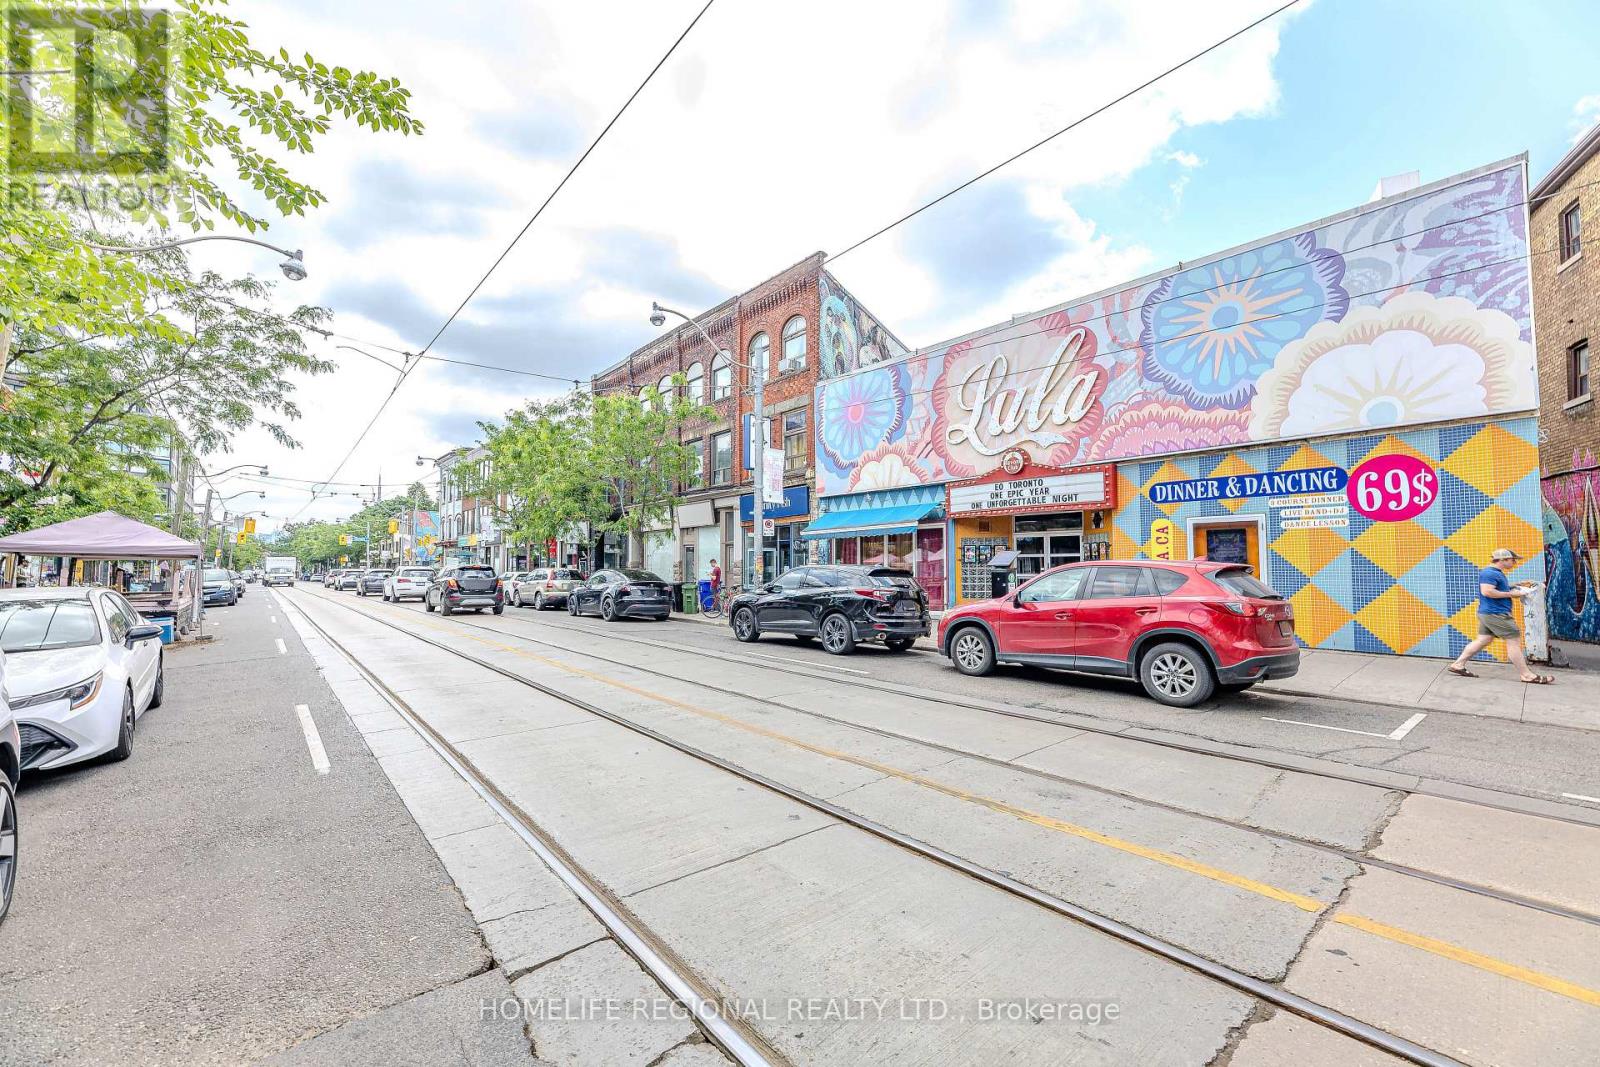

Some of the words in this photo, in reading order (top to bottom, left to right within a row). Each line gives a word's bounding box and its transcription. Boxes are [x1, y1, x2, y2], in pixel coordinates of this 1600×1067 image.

[946, 328, 1099, 456] Lula
[1008, 479, 1044, 489] TORONTO
[1155, 480, 1219, 502] DINNER
[1225, 476, 1242, 498] &
[1244, 468, 1338, 495] DANCING
[1357, 467, 1433, 513] 69$
[990, 491, 1003, 500] ONE
[1007, 489, 1024, 498] EPIC
[1029, 487, 1050, 496] YEAR
[1311, 495, 1344, 503] DINNER
[970, 502, 983, 510] ONE
[986, 496, 1047, 508] UNFORGETTABLE
[1052, 493, 1079, 503] NIGHT
[1313, 519, 1347, 527] LESSON
